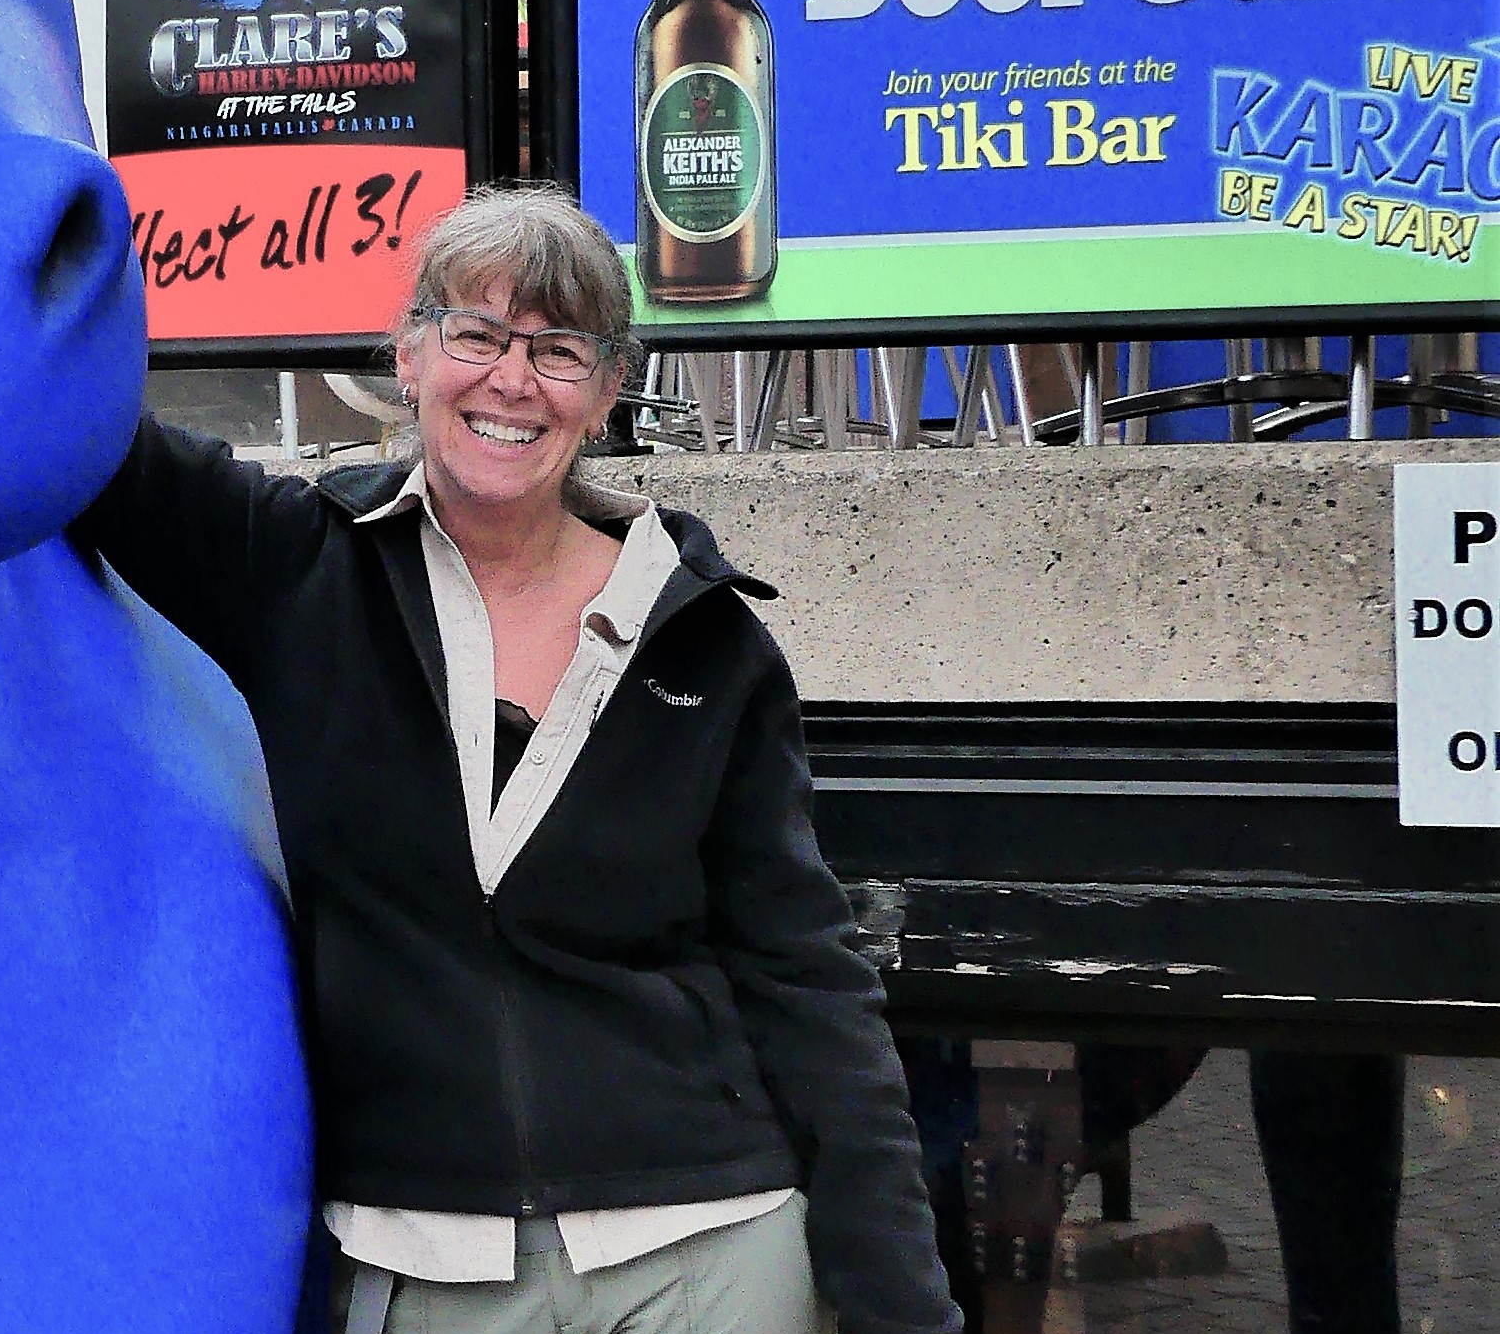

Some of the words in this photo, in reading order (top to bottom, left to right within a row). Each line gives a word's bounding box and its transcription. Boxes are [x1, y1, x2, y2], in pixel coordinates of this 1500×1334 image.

[150, 6, 409, 98] CLARE'S
[197, 61, 417, 96] HARLEY-DAVIDSON
[882, 68, 932, 96] Join
[939, 70, 999, 98] your
[1000, 59, 1092, 96] friends
[1098, 61, 1129, 85] at
[1133, 56, 1177, 84] the
[1366, 46, 1479, 104] LIVE
[216, 96, 248, 120] AT
[243, 95, 288, 117] THE
[289, 91, 357, 116] FALLS
[166, 125, 252, 141] NIAGARA
[261, 121, 320, 136] FALLS
[338, 115, 416, 132] CANADA
[663, 135, 742, 152] ALEXANDER
[884, 100, 1029, 173] Tiki
[1043, 98, 1178, 167] Bar
[662, 150, 744, 175] KEITH'S
[668, 175, 695, 185] INDIA
[696, 173, 719, 184] PALE
[719, 172, 737, 184] ALE
[260, 183, 341, 269] all
[351, 170, 422, 256] 3!
[1219, 169, 1278, 222] BE
[1283, 184, 1326, 233] A
[1336, 194, 1480, 263] STAR!
